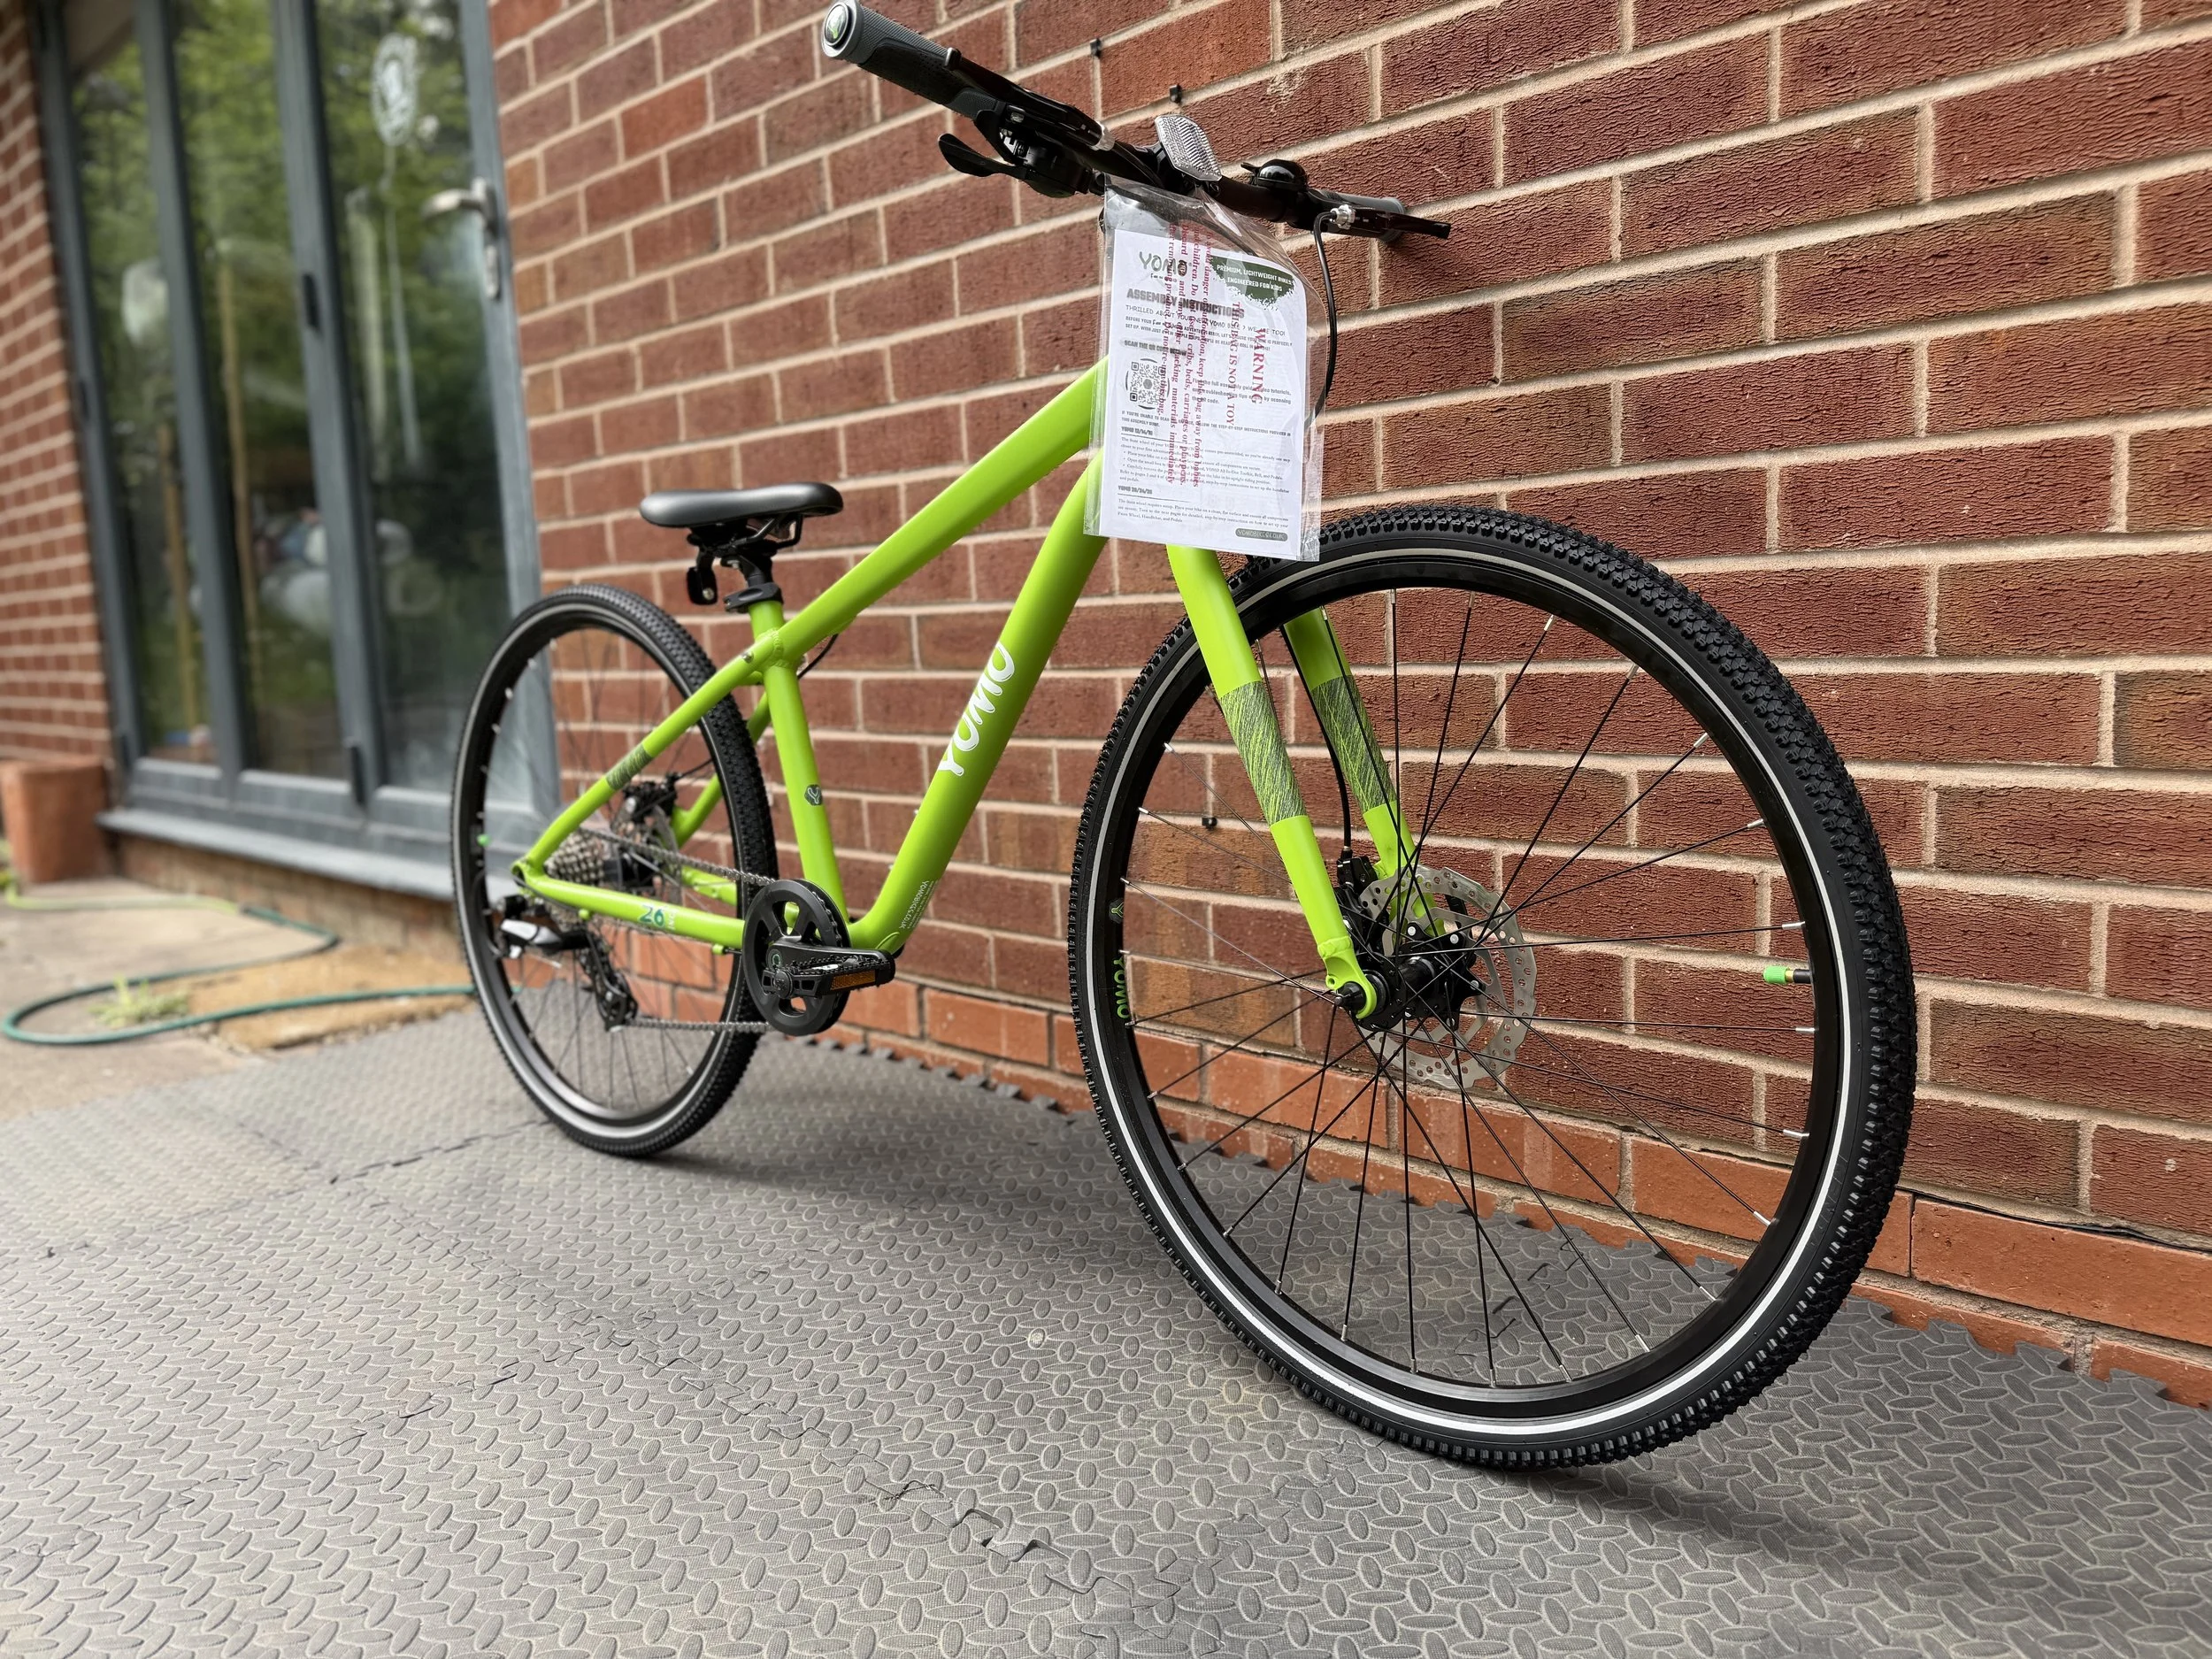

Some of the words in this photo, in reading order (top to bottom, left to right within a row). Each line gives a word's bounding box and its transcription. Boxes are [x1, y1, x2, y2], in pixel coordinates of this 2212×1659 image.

[1180, 224, 1189, 256] Discard
[1139, 251, 1187, 277] YOMO
[1164, 242, 1175, 282] removing
[1192, 243, 1201, 281] children.
[1217, 265, 1242, 274] PREMIUM,
[1243, 269, 1278, 281] LIGHTWEIGHT
[1278, 276, 1292, 285] BIKES
[1191, 283, 1199, 296] Do
[1202, 265, 1211, 296] danger
[1227, 277, 1259, 288] ENGINEERED
[1271, 283, 1283, 292] KIDS
[1125, 304, 1154, 315] THRILLED
[1156, 310, 1175, 319] ABOT
[1210, 319, 1225, 328] YOMO
[1126, 288, 1178, 306] ASSEMBY
[1180, 297, 1245, 319] NSTRUCTIOS
[1231, 302, 1240, 330] THIS
[1230, 330, 1239, 352] BAG
[1185, 343, 1194, 366] cribs,
[1197, 357, 1206, 378] keep
[1228, 354, 1237, 365] IS
[1251, 328, 1266, 404] WARNING
[1183, 368, 1193, 391] beds,
[1227, 367, 1237, 391] NOT
[1170, 388, 1179, 428] materials
[1194, 397, 1203, 412] bag
[1227, 392, 1236, 401] A
[1180, 393, 1191, 433] carriages
[1226, 403, 1235, 426] TOY
[1182, 434, 1187, 444] or
[1166, 432, 1177, 484] immediately
[1179, 445, 1188, 486] playpens.
[1193, 461, 1202, 488] babies
[937, 641, 1016, 777] YOMO
[637, 903, 666, 929] 26
[1113, 956, 1132, 1019] YOMO
